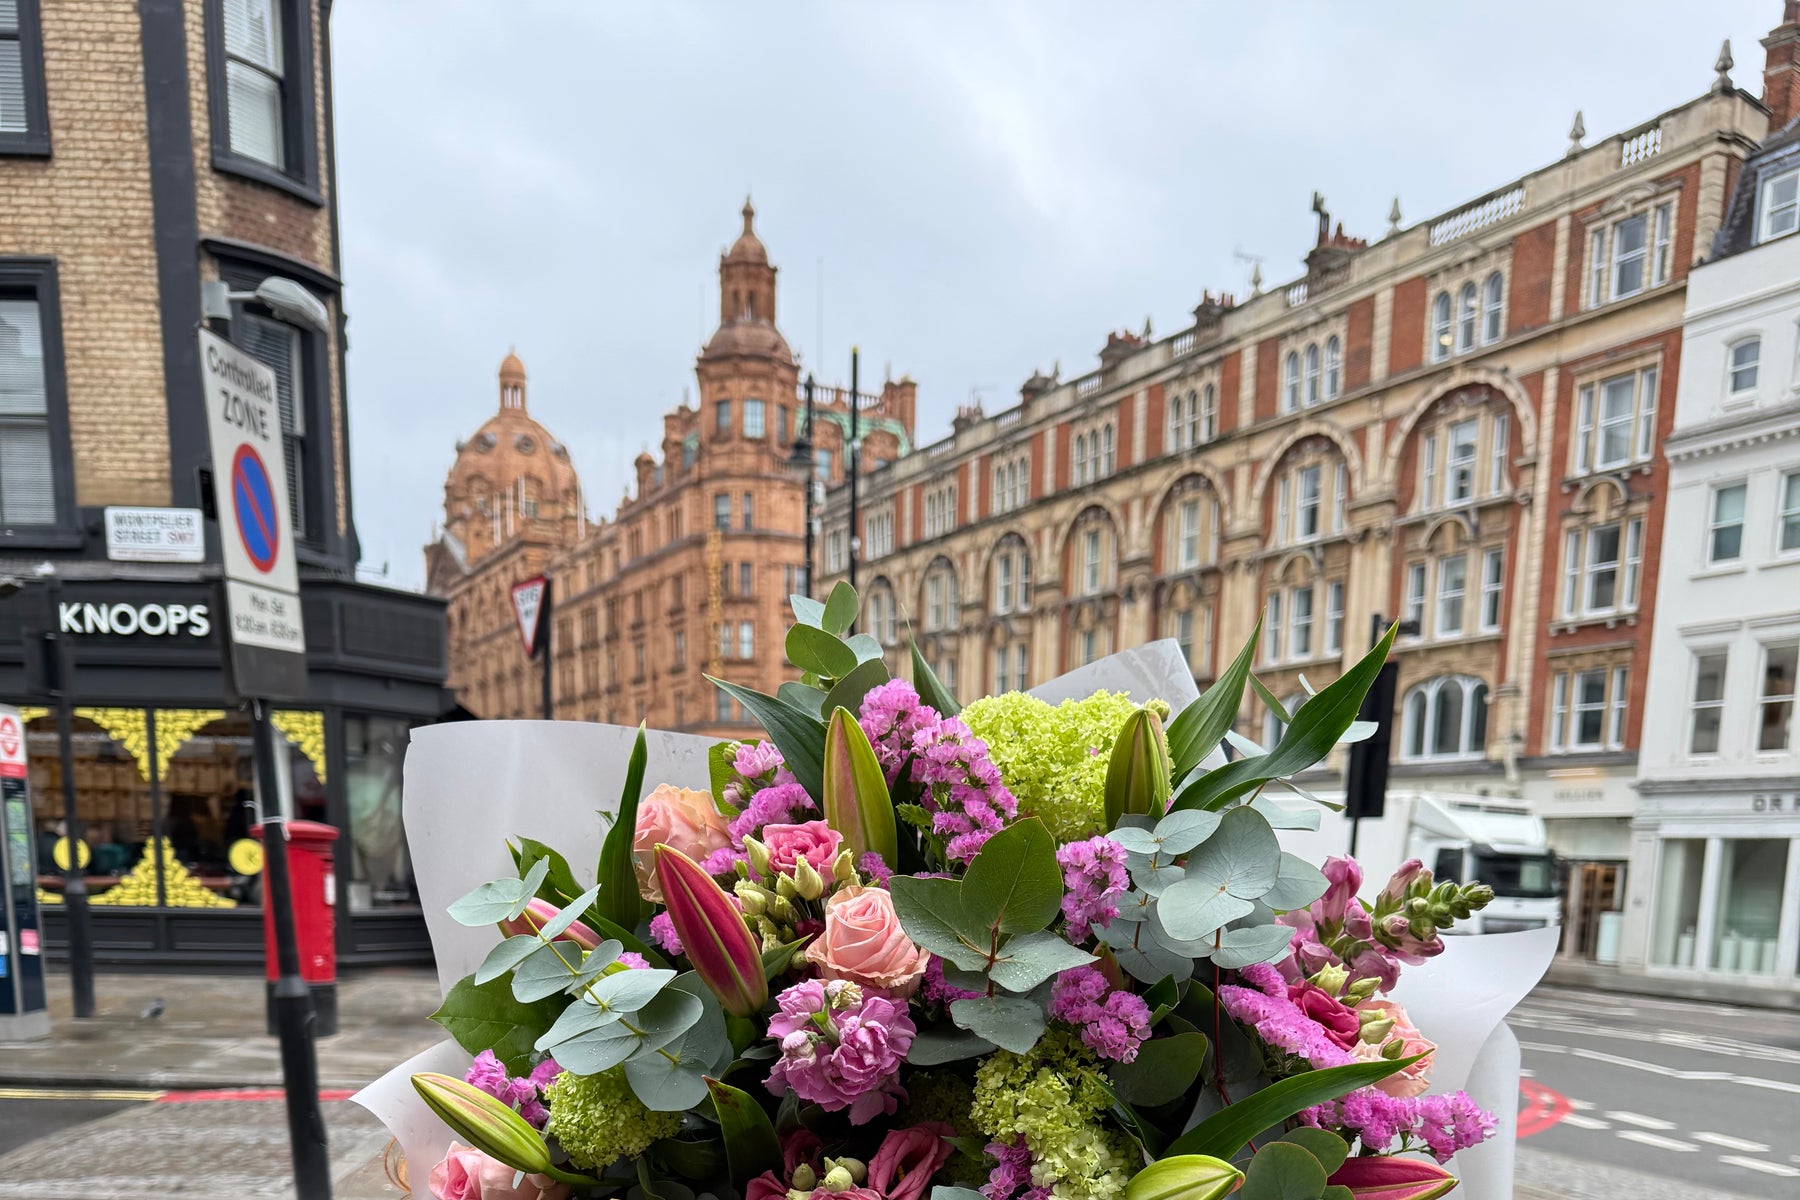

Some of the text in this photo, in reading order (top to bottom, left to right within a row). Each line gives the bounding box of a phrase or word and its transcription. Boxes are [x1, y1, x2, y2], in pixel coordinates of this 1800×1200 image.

[206, 345, 273, 403] Controlled
[221, 389, 270, 441] ZONE
[114, 512, 194, 530] MONTPELIER
[114, 528, 161, 544] STREET
[59, 602, 211, 637] KNOOPS
[1753, 793, 1783, 812] DR
